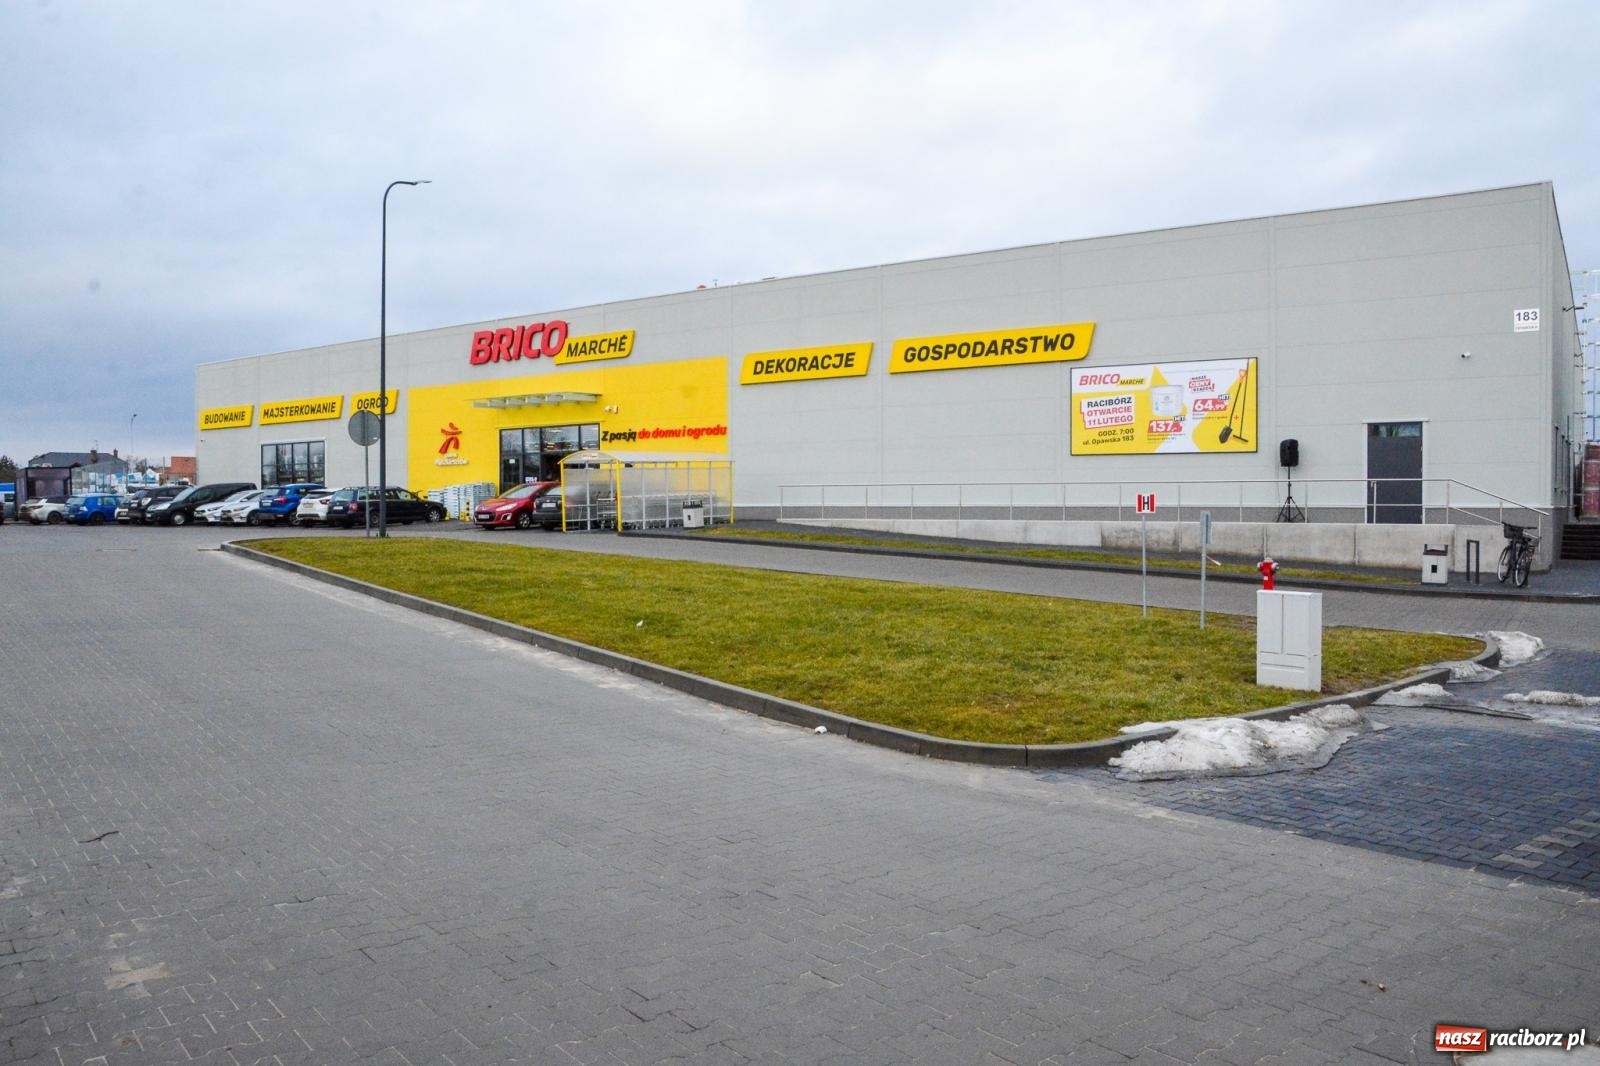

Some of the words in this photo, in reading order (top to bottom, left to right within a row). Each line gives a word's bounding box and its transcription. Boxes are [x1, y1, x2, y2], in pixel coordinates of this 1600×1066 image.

[1515, 311, 1538, 321] 183
[470, 320, 568, 365] BRICO
[904, 333, 1076, 363] GOSPODARSTWO
[753, 352, 856, 375] DEKORACJE
[1079, 373, 1121, 386] BRICO
[1087, 396, 1132, 408] RACIBÓRZ
[263, 402, 336, 419] MAJSTERKOWANIE
[1087, 406, 1132, 417] OTWARCIE
[204, 411, 246, 424] BUDOWANIE
[1097, 415, 1133, 425] LUTEGO
[602, 431, 608, 441] Z
[609, 429, 637, 443] pasją
[638, 428, 650, 439] do
[652, 427, 681, 439] domu
[682, 426, 686, 437] i
[687, 424, 727, 439] ogrodu
[1142, 496, 1149, 510] H
